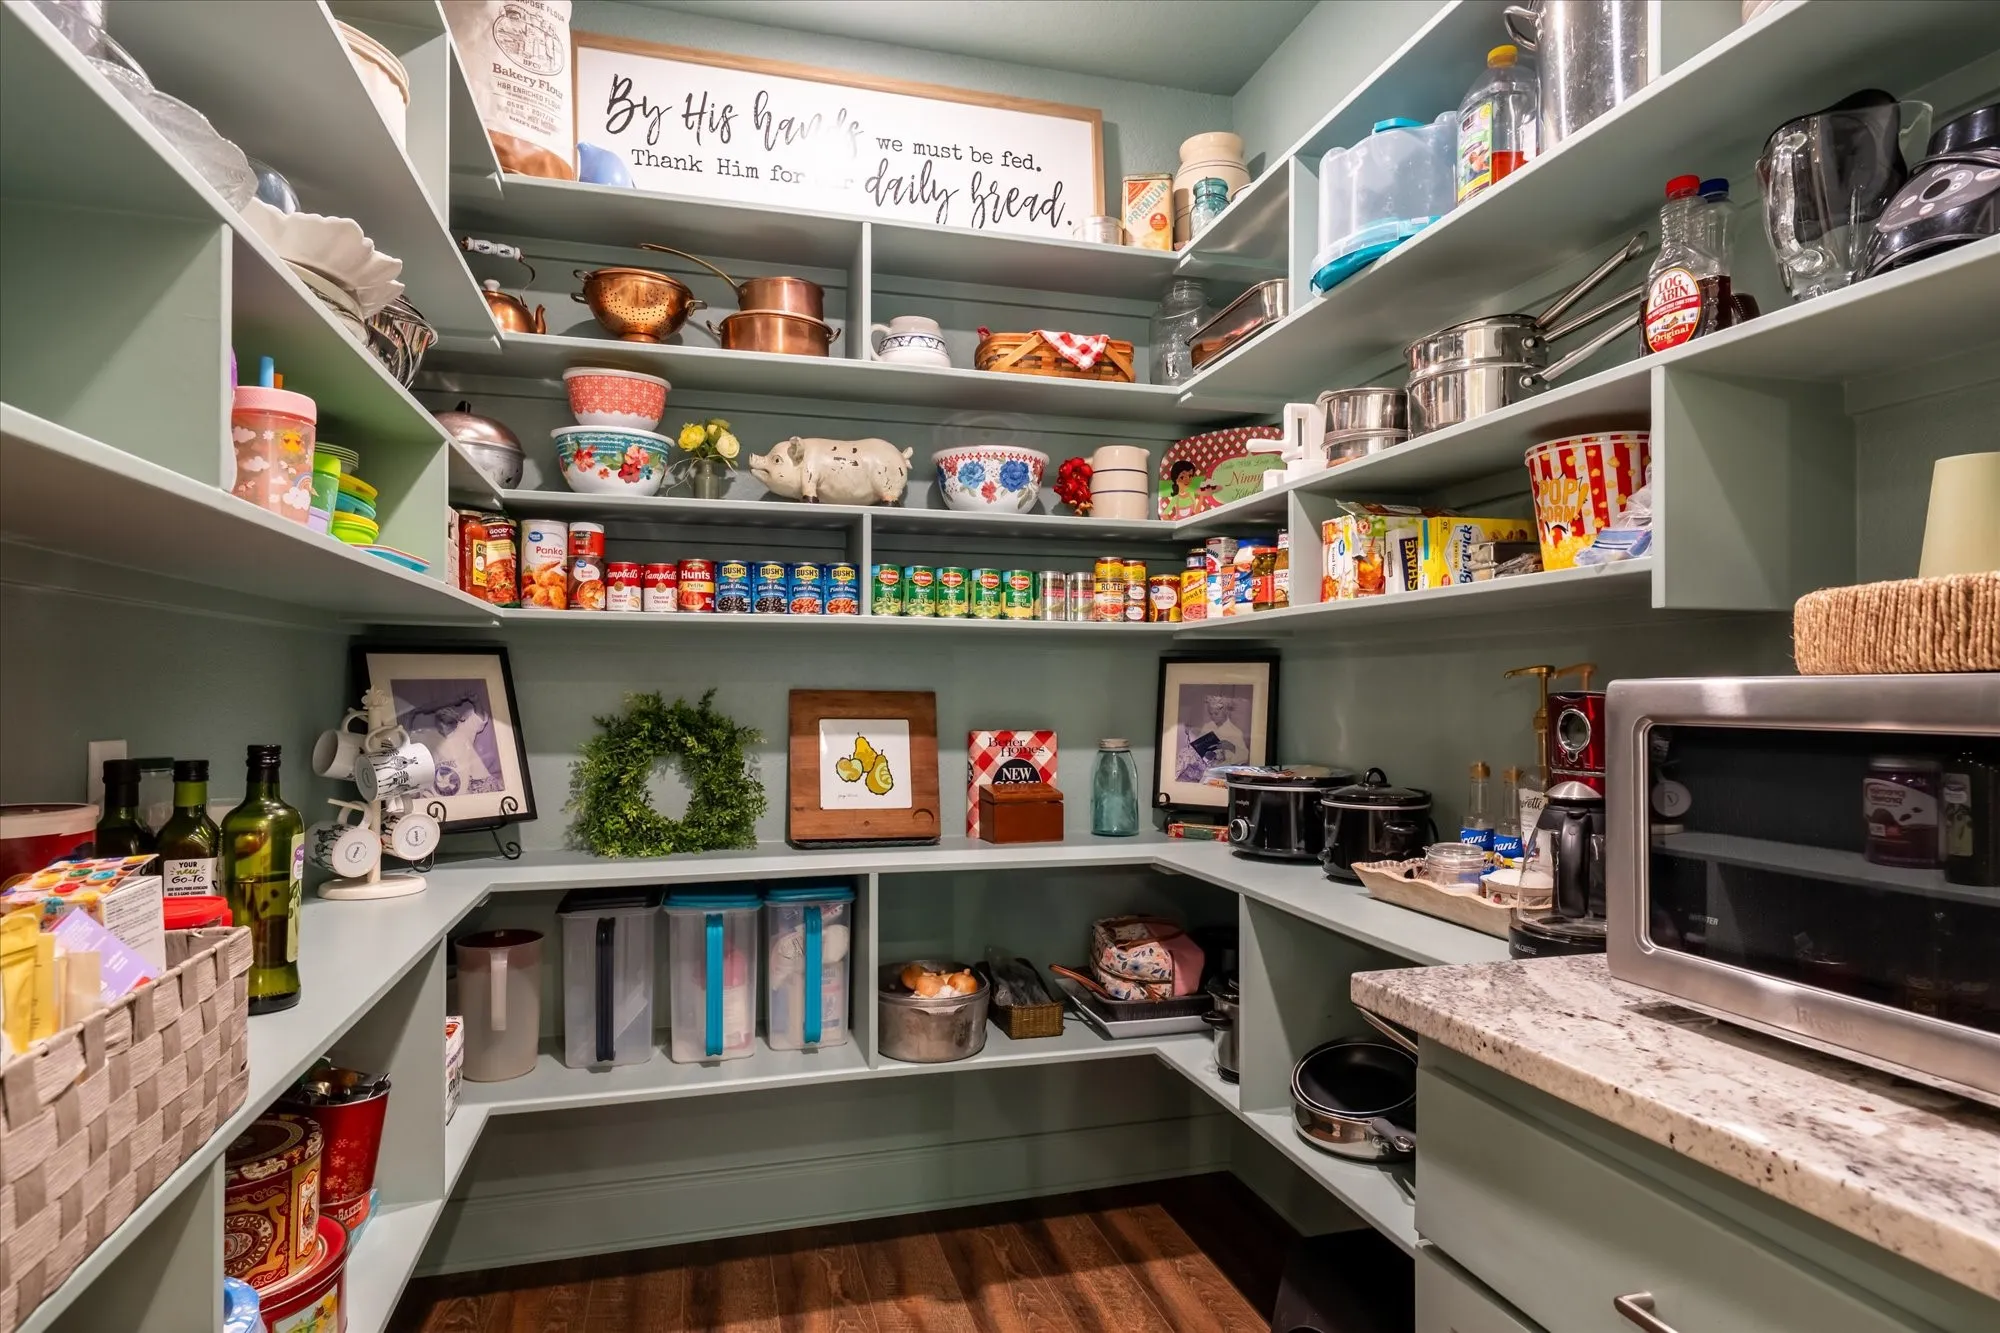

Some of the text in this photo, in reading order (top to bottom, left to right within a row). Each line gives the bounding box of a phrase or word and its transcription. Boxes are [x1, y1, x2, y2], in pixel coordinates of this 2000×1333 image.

[492, 62, 564, 100] Bakery Flour
[513, 85, 544, 102] ENRICHED
[605, 73, 672, 146] By
[681, 91, 738, 145] His
[876, 137, 903, 152] we
[913, 141, 963, 160] must
[969, 146, 993, 165] be
[1001, 151, 1042, 172] fed.
[631, 149, 703, 173] Thank
[716, 158, 759, 179] Him
[770, 165, 805, 184] for
[865, 158, 959, 225] daily
[971, 171, 1072, 229] bread.
[1127, 181, 1169, 225] PREMIUM
[1658, 274, 1682, 295] LOG
[1653, 284, 1689, 308] CABIN
[1653, 324, 1689, 343] Original
[1225, 470, 1264, 488] Ninny
[535, 546, 563, 556] Panko
[1460, 524, 1473, 583] Bisquick
[723, 567, 746, 576] BUSH'S
[761, 567, 784, 576] BUSH'S
[1405, 540, 1417, 590] SHAKE
[681, 570, 711, 580] Hunt's
[796, 569, 818, 577] BUSH'S
[833, 570, 854, 578] BUSH'S
[988, 737, 1026, 748] Better
[1001, 746, 1045, 758] Homes
[1002, 767, 1032, 780] NEW
[1461, 831, 1488, 844] rani
[1494, 838, 1519, 851] rani
